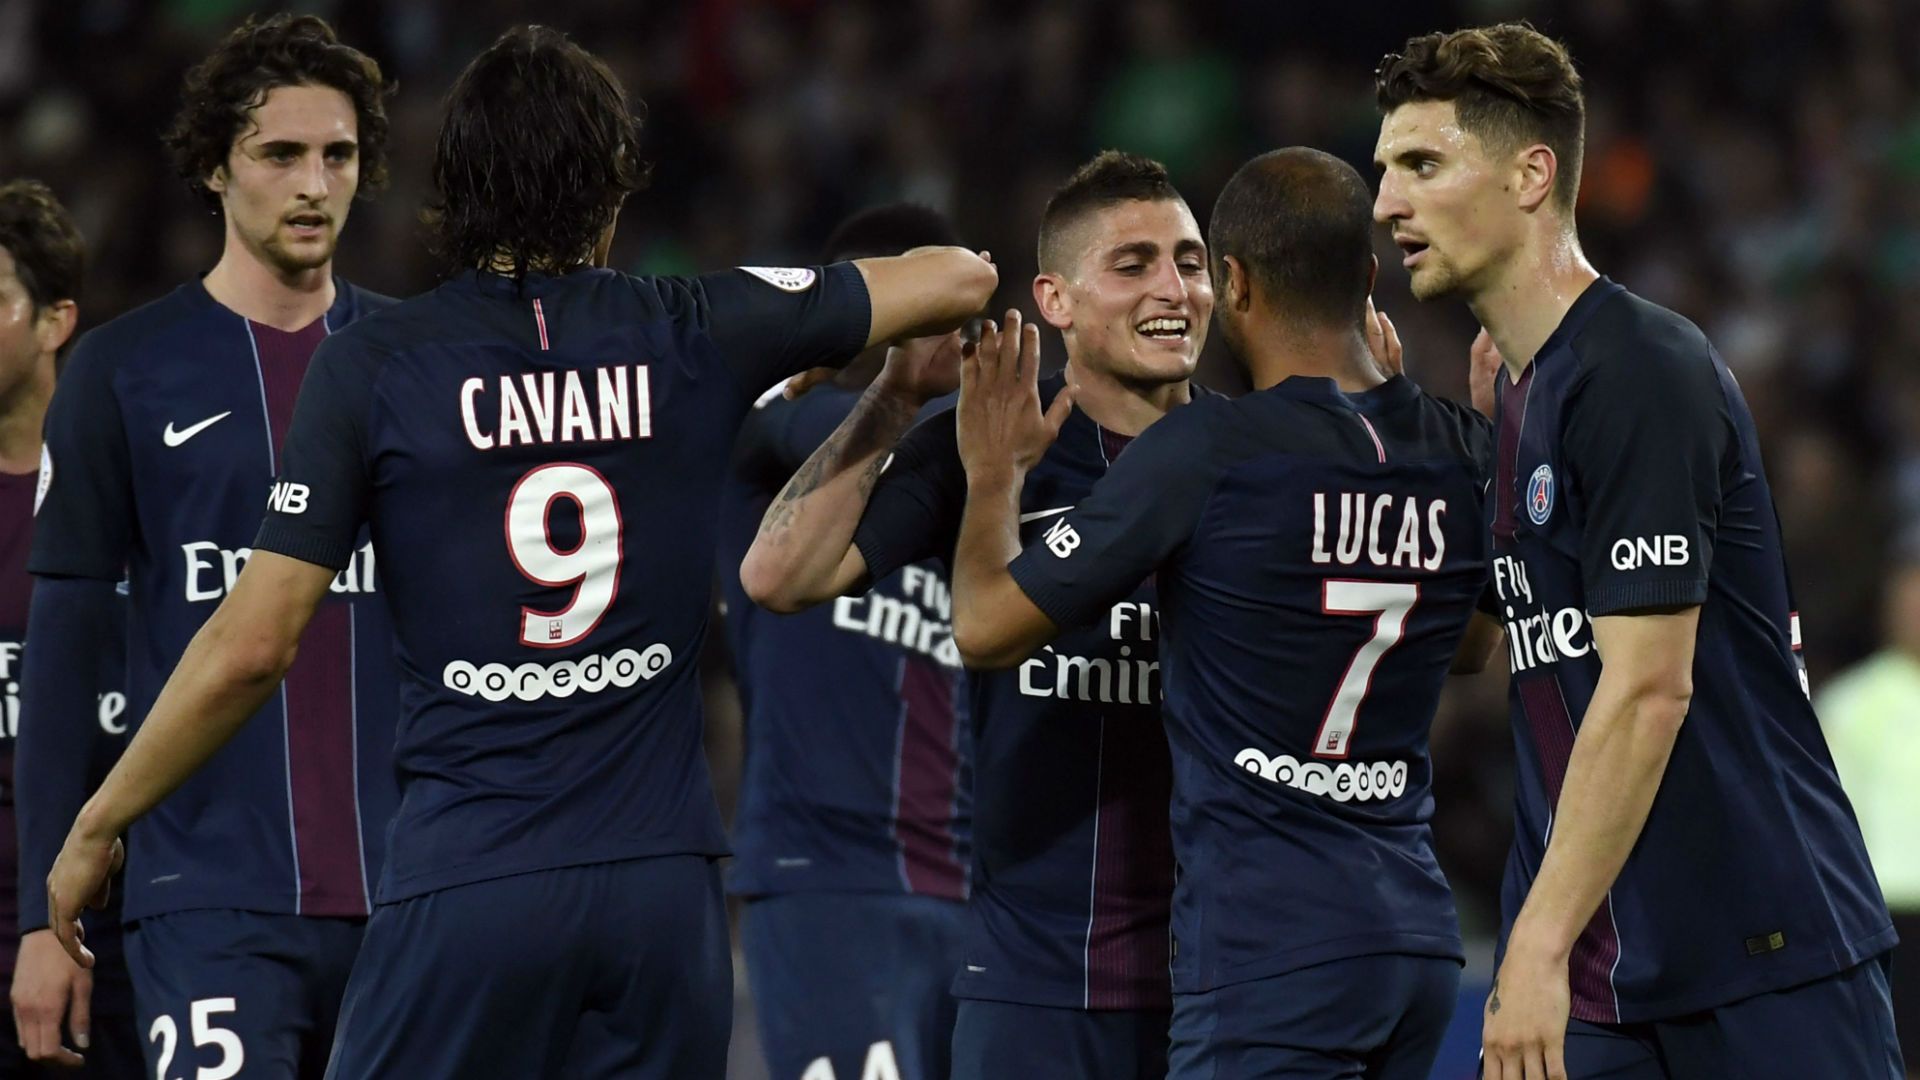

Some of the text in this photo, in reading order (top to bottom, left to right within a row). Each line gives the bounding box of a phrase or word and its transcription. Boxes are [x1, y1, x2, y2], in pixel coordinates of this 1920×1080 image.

[459, 364, 653, 450] CAVANI
[266, 481, 310, 514] NB
[504, 461, 624, 649] 9
[1042, 516, 1081, 559] NB
[1311, 492, 1448, 571] LUCAS
[1610, 534, 1690, 571] QNB
[1493, 555, 1533, 604] Fly
[1110, 602, 1160, 641] Fl
[443, 643, 672, 702] ooredoo
[1019, 644, 1163, 705] Emir
[1311, 578, 1421, 759] 7
[1233, 747, 1408, 802] ooredoo
[149, 997, 244, 1080] 25
